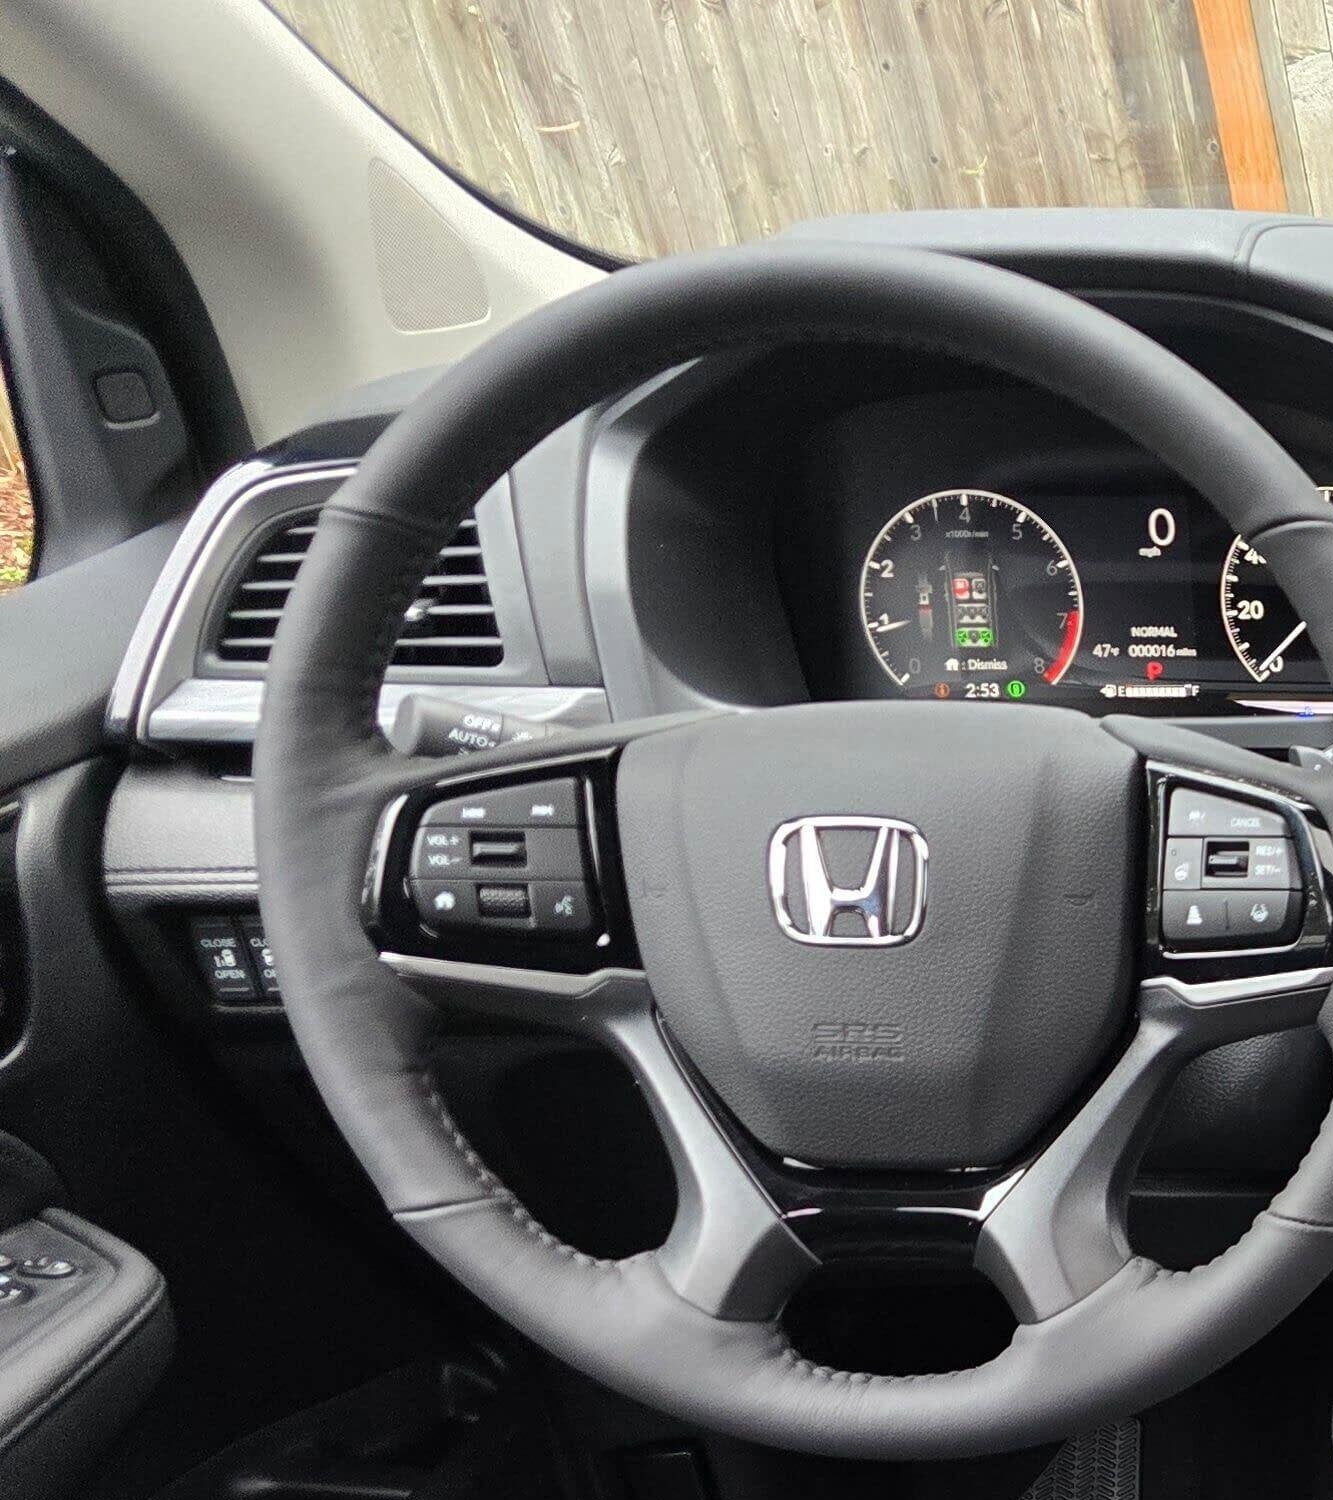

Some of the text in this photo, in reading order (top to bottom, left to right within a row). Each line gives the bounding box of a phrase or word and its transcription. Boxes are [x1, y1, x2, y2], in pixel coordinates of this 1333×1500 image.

[959, 508, 970, 523] 4
[910, 525, 922, 542] 3
[1012, 524, 1022, 540] 5
[1148, 508, 1176, 546] 0
[880, 560, 894, 578] 2
[1046, 560, 1058, 576] 6
[1238, 600, 1264, 620] 20
[1130, 626, 1178, 638] NORMAL
[1128, 644, 1176, 657] 000016
[968, 659, 1008, 670] Dismiss
[1034, 658, 1045, 674] 8
[1146, 661, 1164, 681] P
[964, 684, 1000, 698] 2:53
[448, 728, 487, 747] AUTO
[1230, 817, 1261, 828] CANCEL
[200, 938, 236, 948] CLOSE
[214, 970, 246, 979] OPEN
